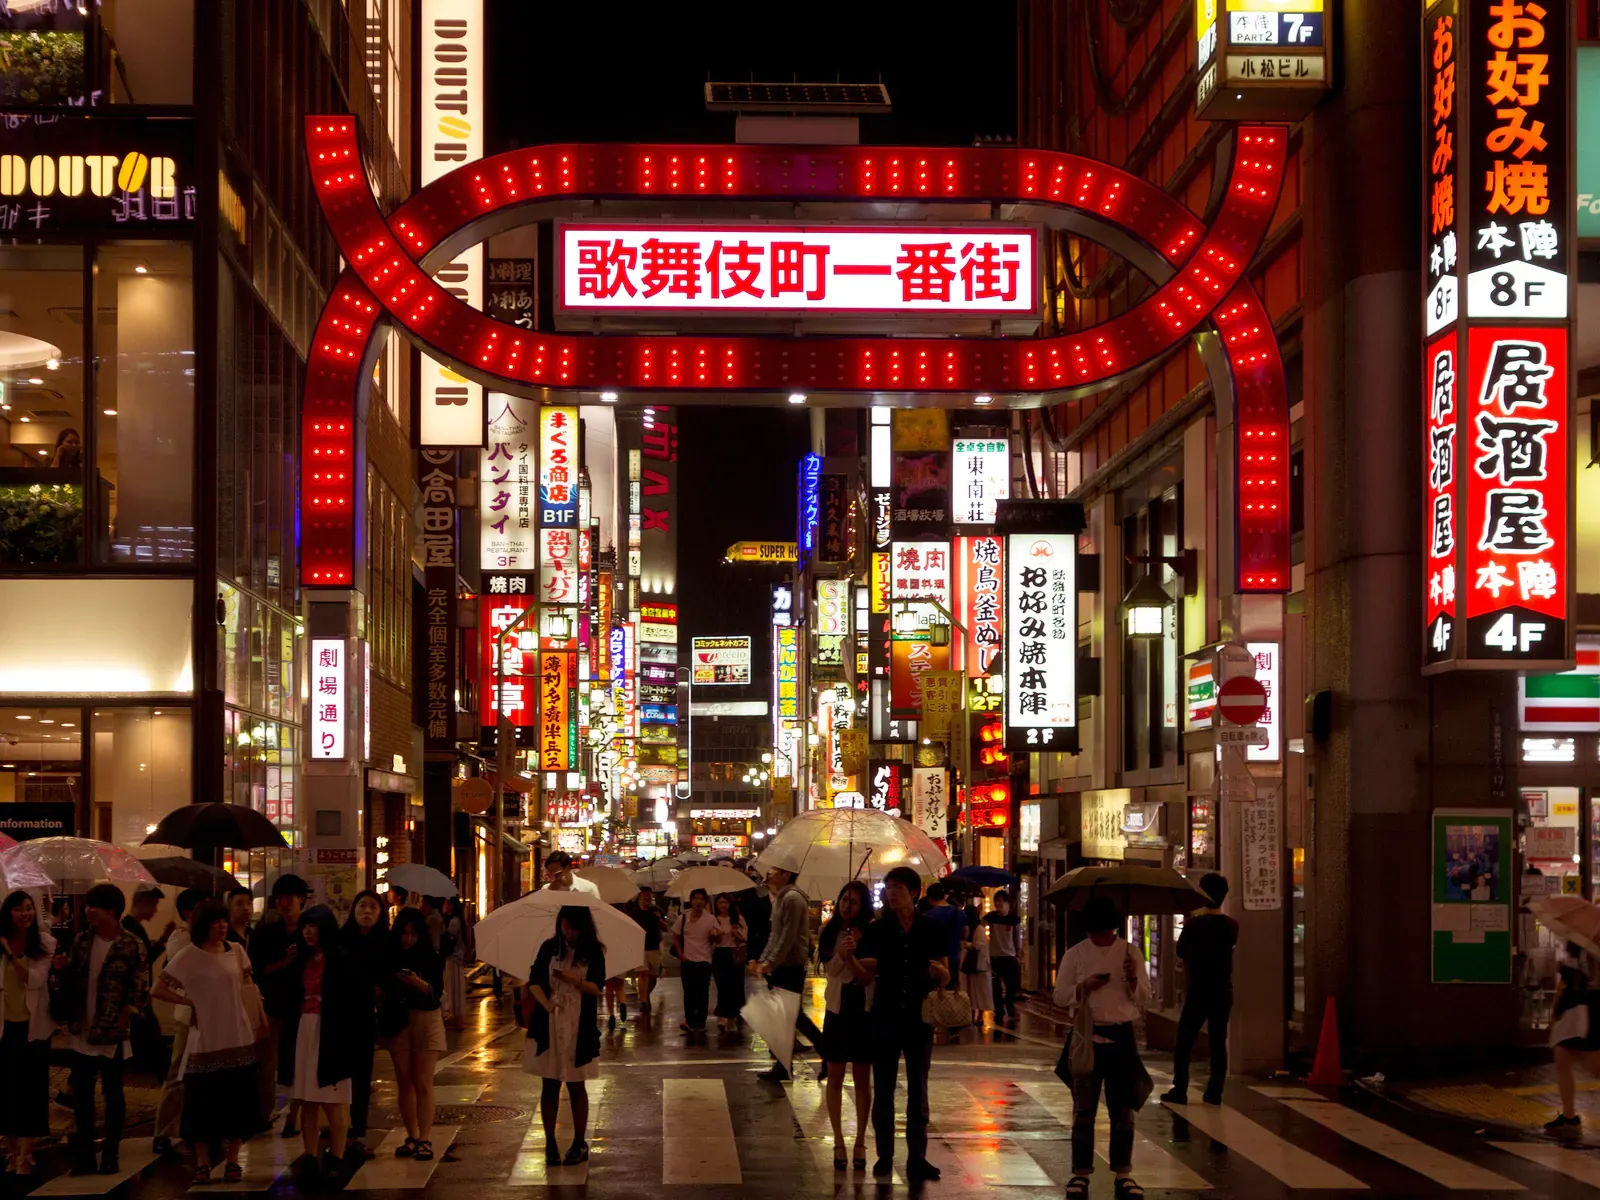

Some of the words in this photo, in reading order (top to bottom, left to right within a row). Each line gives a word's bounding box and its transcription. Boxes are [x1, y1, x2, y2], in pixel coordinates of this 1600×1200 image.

[1283, 13, 1314, 43] 7F
[1241, 58, 1309, 78] 小松ビル
[433, 18, 473, 162] DOUTOR
[1485, 1, 1551, 216] お好み焼
[1431, 16, 1456, 235] お好み焼
[0, 151, 176, 198] DOUTOR
[1430, 231, 1457, 276] 本陣
[1477, 220, 1559, 262] 本陣
[577, 237, 1021, 303] 歌舞伎町一番街
[1489, 271, 1546, 308] 8F
[1435, 286, 1453, 320] 8F
[548, 411, 571, 505] まぐろ商店
[955, 441, 1006, 453] 全卓全自動
[1430, 350, 1456, 559] 居酒屋
[1474, 340, 1559, 555] 居酒屋
[487, 442, 514, 535] バンタイ
[967, 455, 985, 522] 東南荘
[422, 468, 456, 568] 高田屋
[543, 510, 575, 523] B1F
[497, 556, 518, 567] 3F
[759, 544, 786, 559] SUPER
[489, 576, 526, 594] 焼肉
[896, 578, 946, 590] 韓国料理
[1429, 564, 1456, 606] 本陣
[1475, 559, 1557, 601] 本陣
[973, 537, 1002, 674] 焼鳥釜めし
[1018, 566, 1049, 716] お好み焼本陣
[1432, 617, 1451, 653] 4F
[1485, 613, 1546, 653] 4F
[427, 588, 449, 739] 完全個室多数完備
[318, 647, 338, 750] 劇場通り
[972, 696, 1002, 711] 2F
[1026, 728, 1054, 745] 2F
[924, 773, 945, 831] お好み焼き
